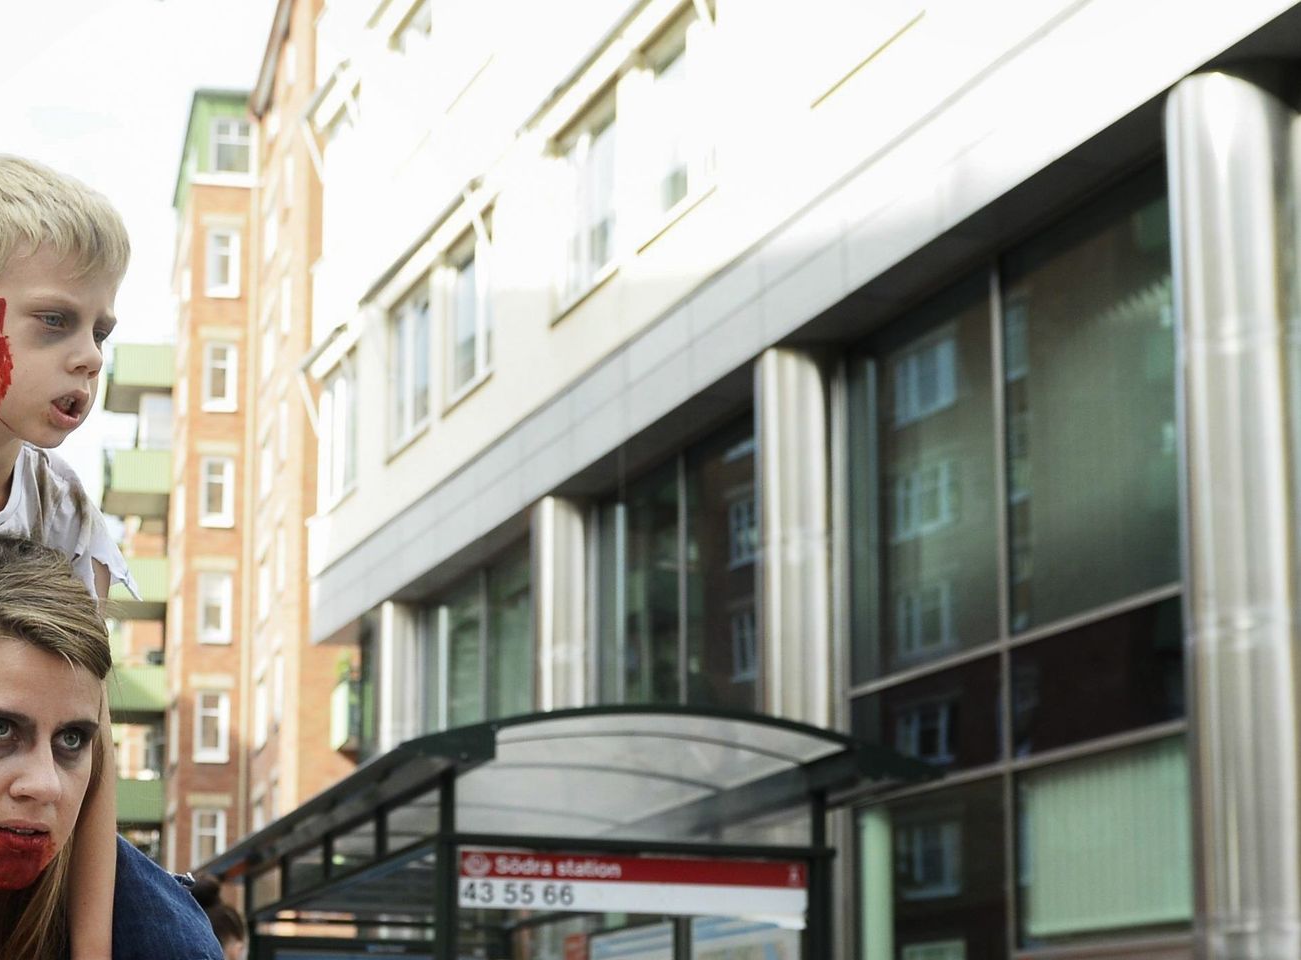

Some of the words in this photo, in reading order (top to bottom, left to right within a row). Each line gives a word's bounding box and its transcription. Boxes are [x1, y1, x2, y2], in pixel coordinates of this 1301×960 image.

[495, 855, 553, 875] Södra
[556, 859, 622, 878] station
[464, 882, 494, 904] 43
[504, 882, 534, 904] 55
[543, 884, 574, 905] 66
